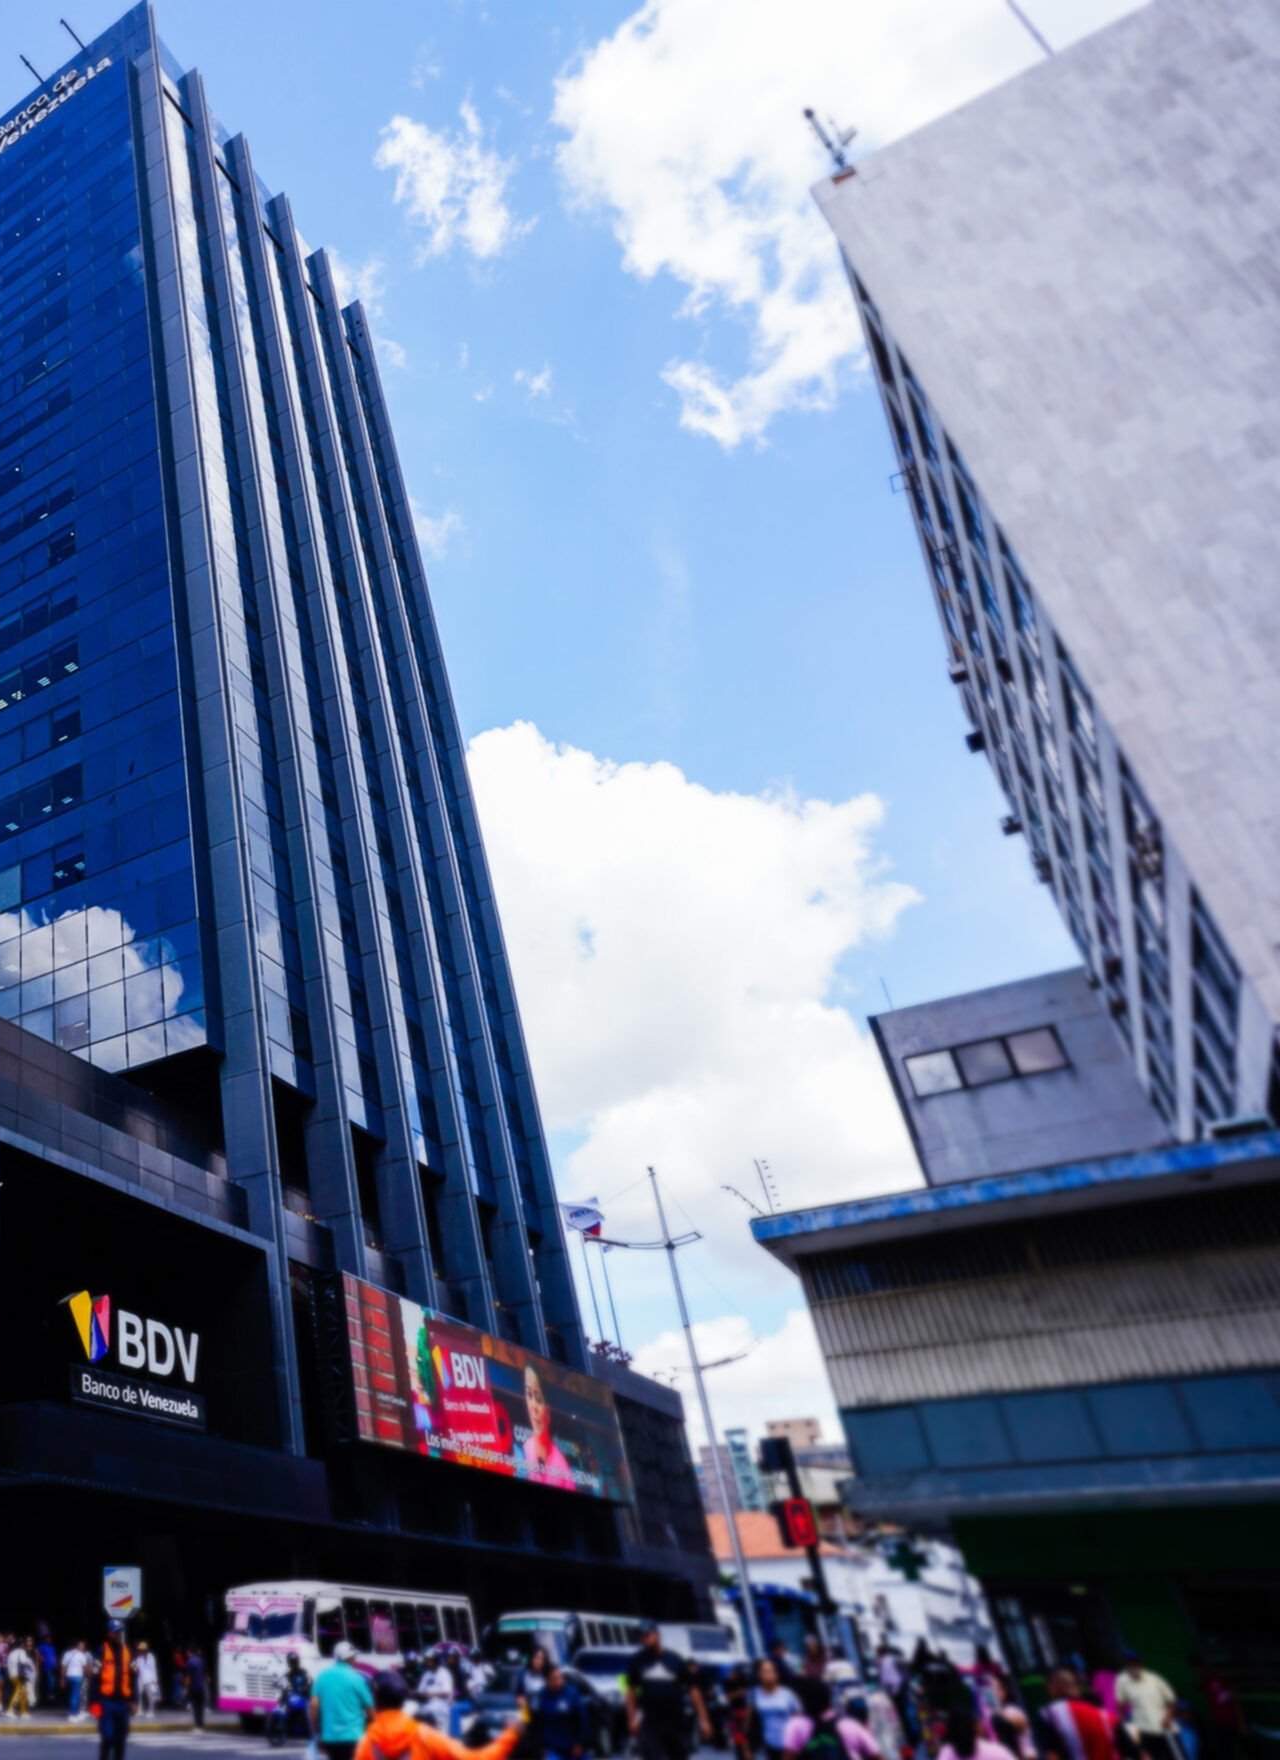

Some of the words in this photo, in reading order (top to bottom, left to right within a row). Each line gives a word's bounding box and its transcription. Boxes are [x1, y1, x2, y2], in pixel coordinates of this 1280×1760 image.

[52, 69, 79, 93] de
[118, 1308, 199, 1384] BDV
[449, 1351, 486, 1391] BDV
[82, 1373, 120, 1401] Banco
[122, 1385, 137, 1405] de
[138, 1387, 199, 1419] Venezuela
